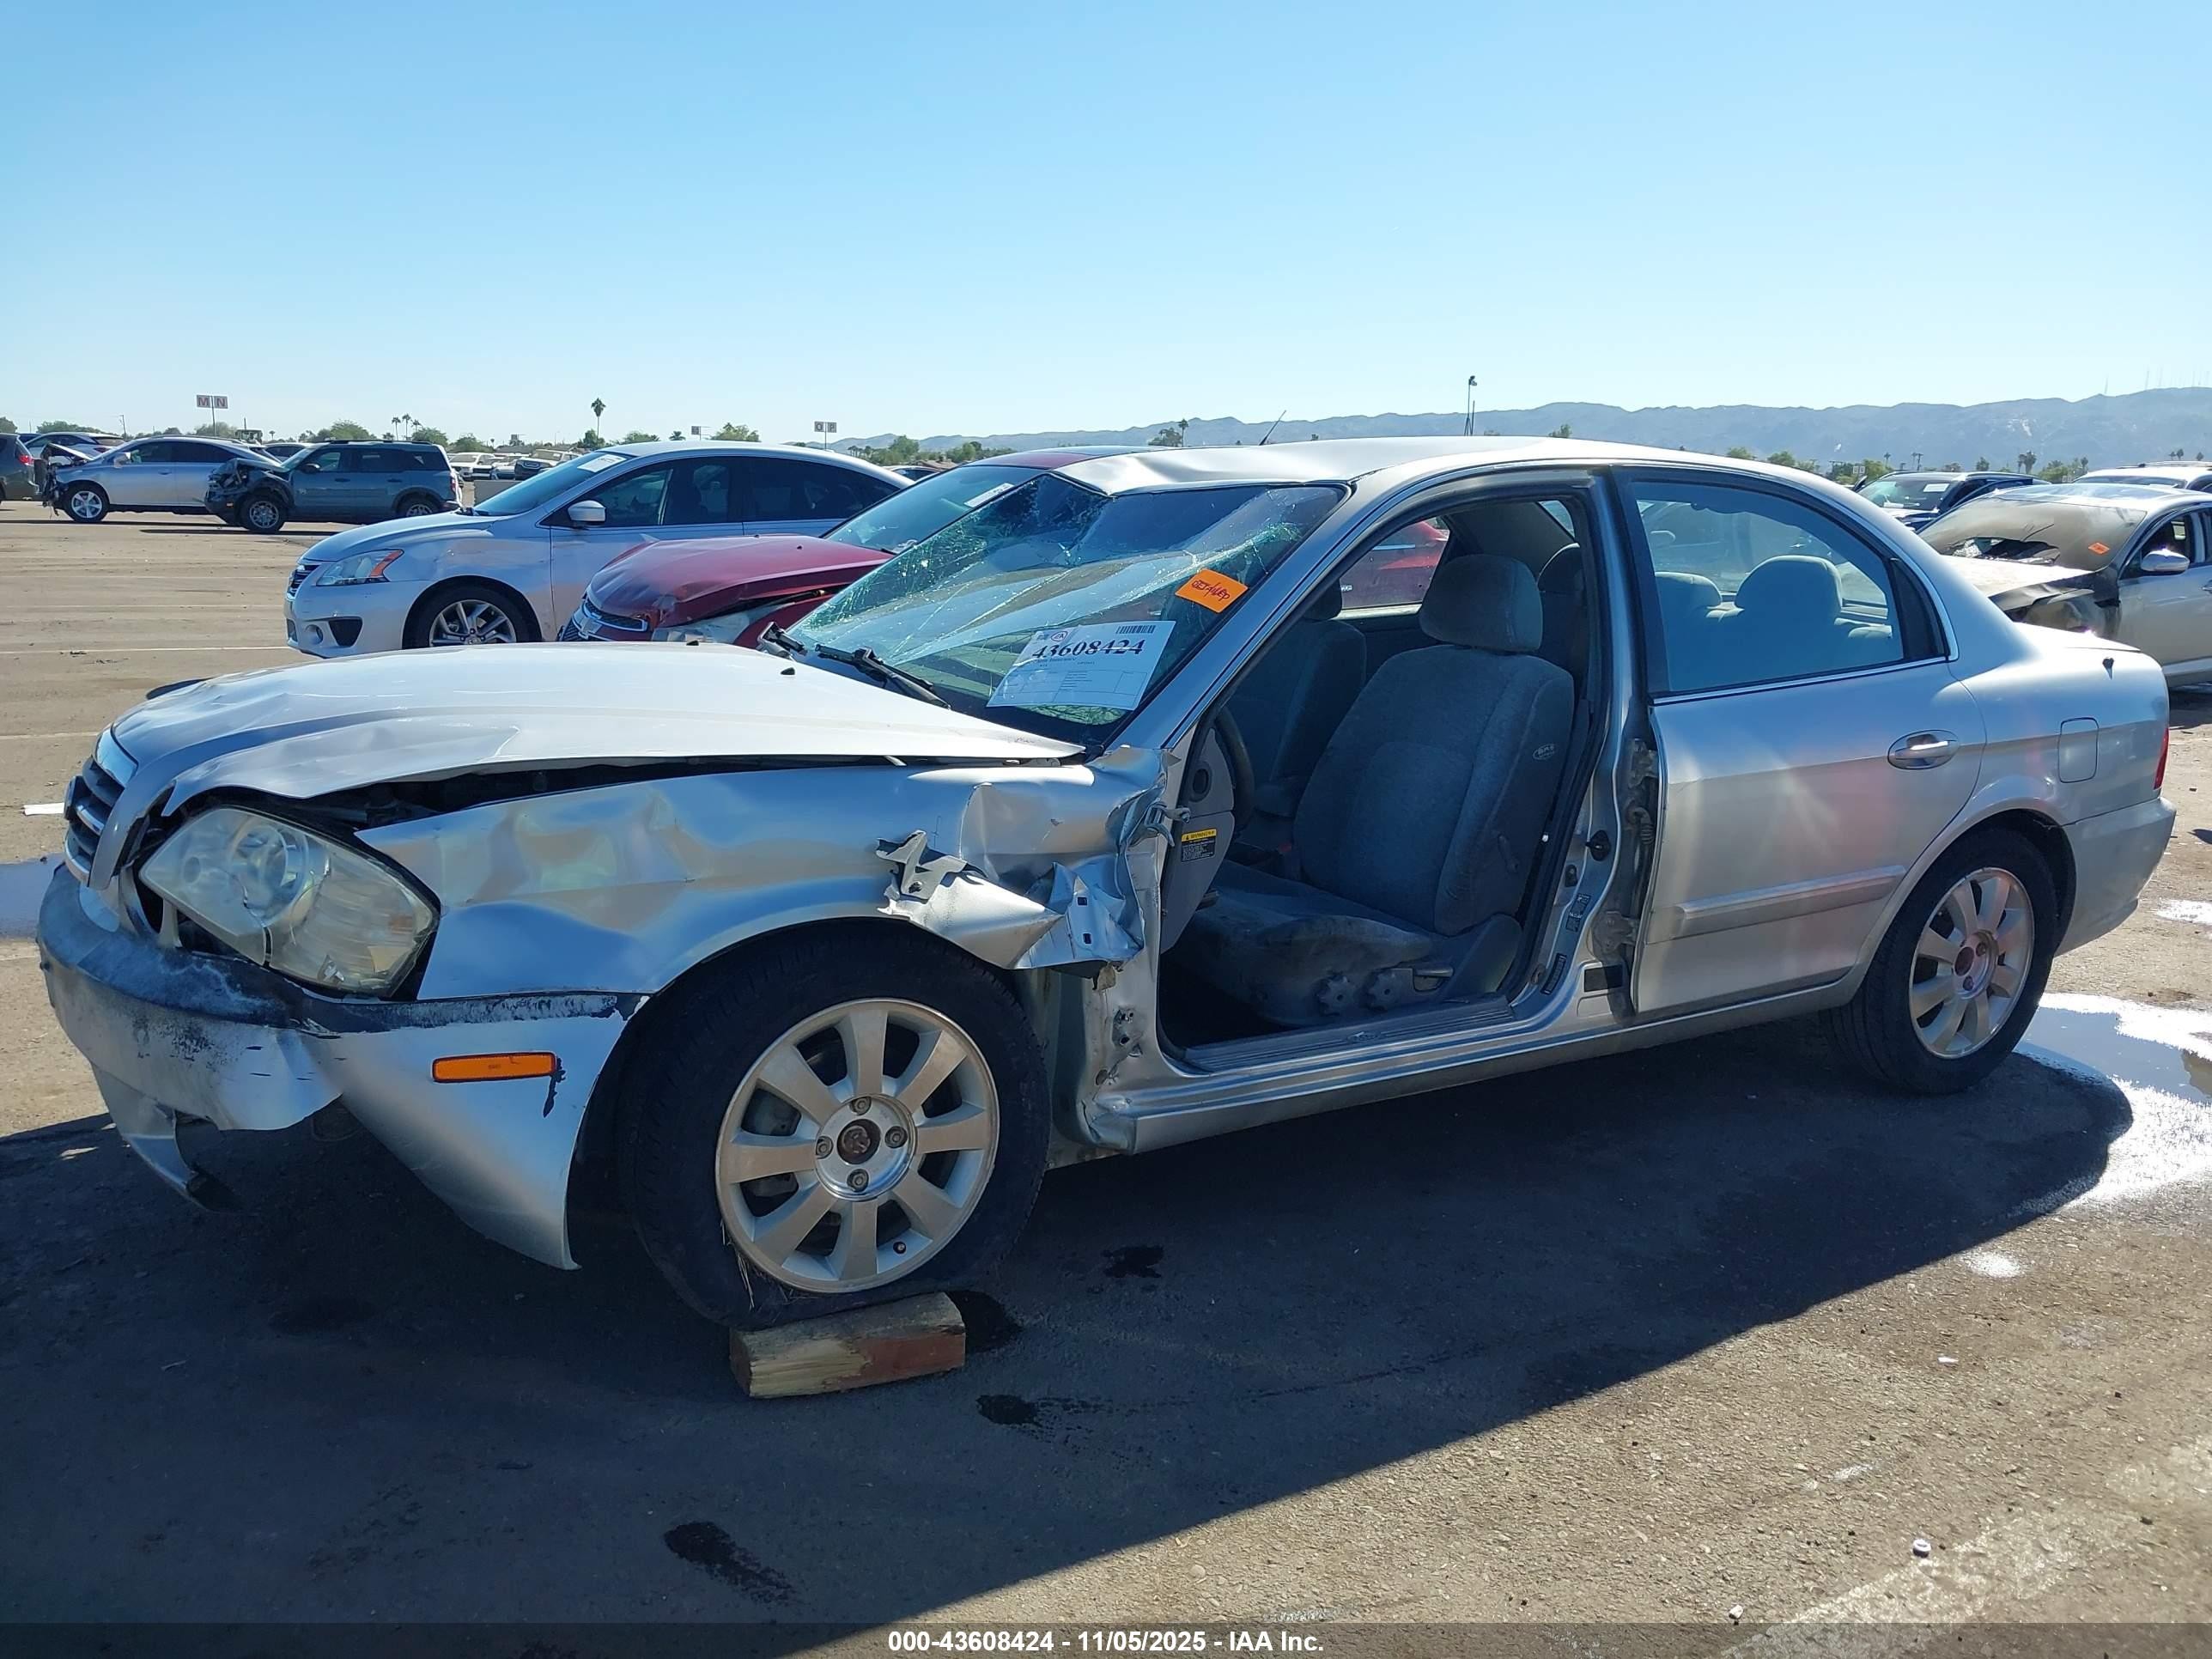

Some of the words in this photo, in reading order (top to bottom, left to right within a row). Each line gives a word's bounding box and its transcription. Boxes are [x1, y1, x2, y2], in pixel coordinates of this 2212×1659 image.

[198, 397, 210, 406] M
[217, 398, 226, 407] N
[1032, 639, 1146, 659] 43608424
